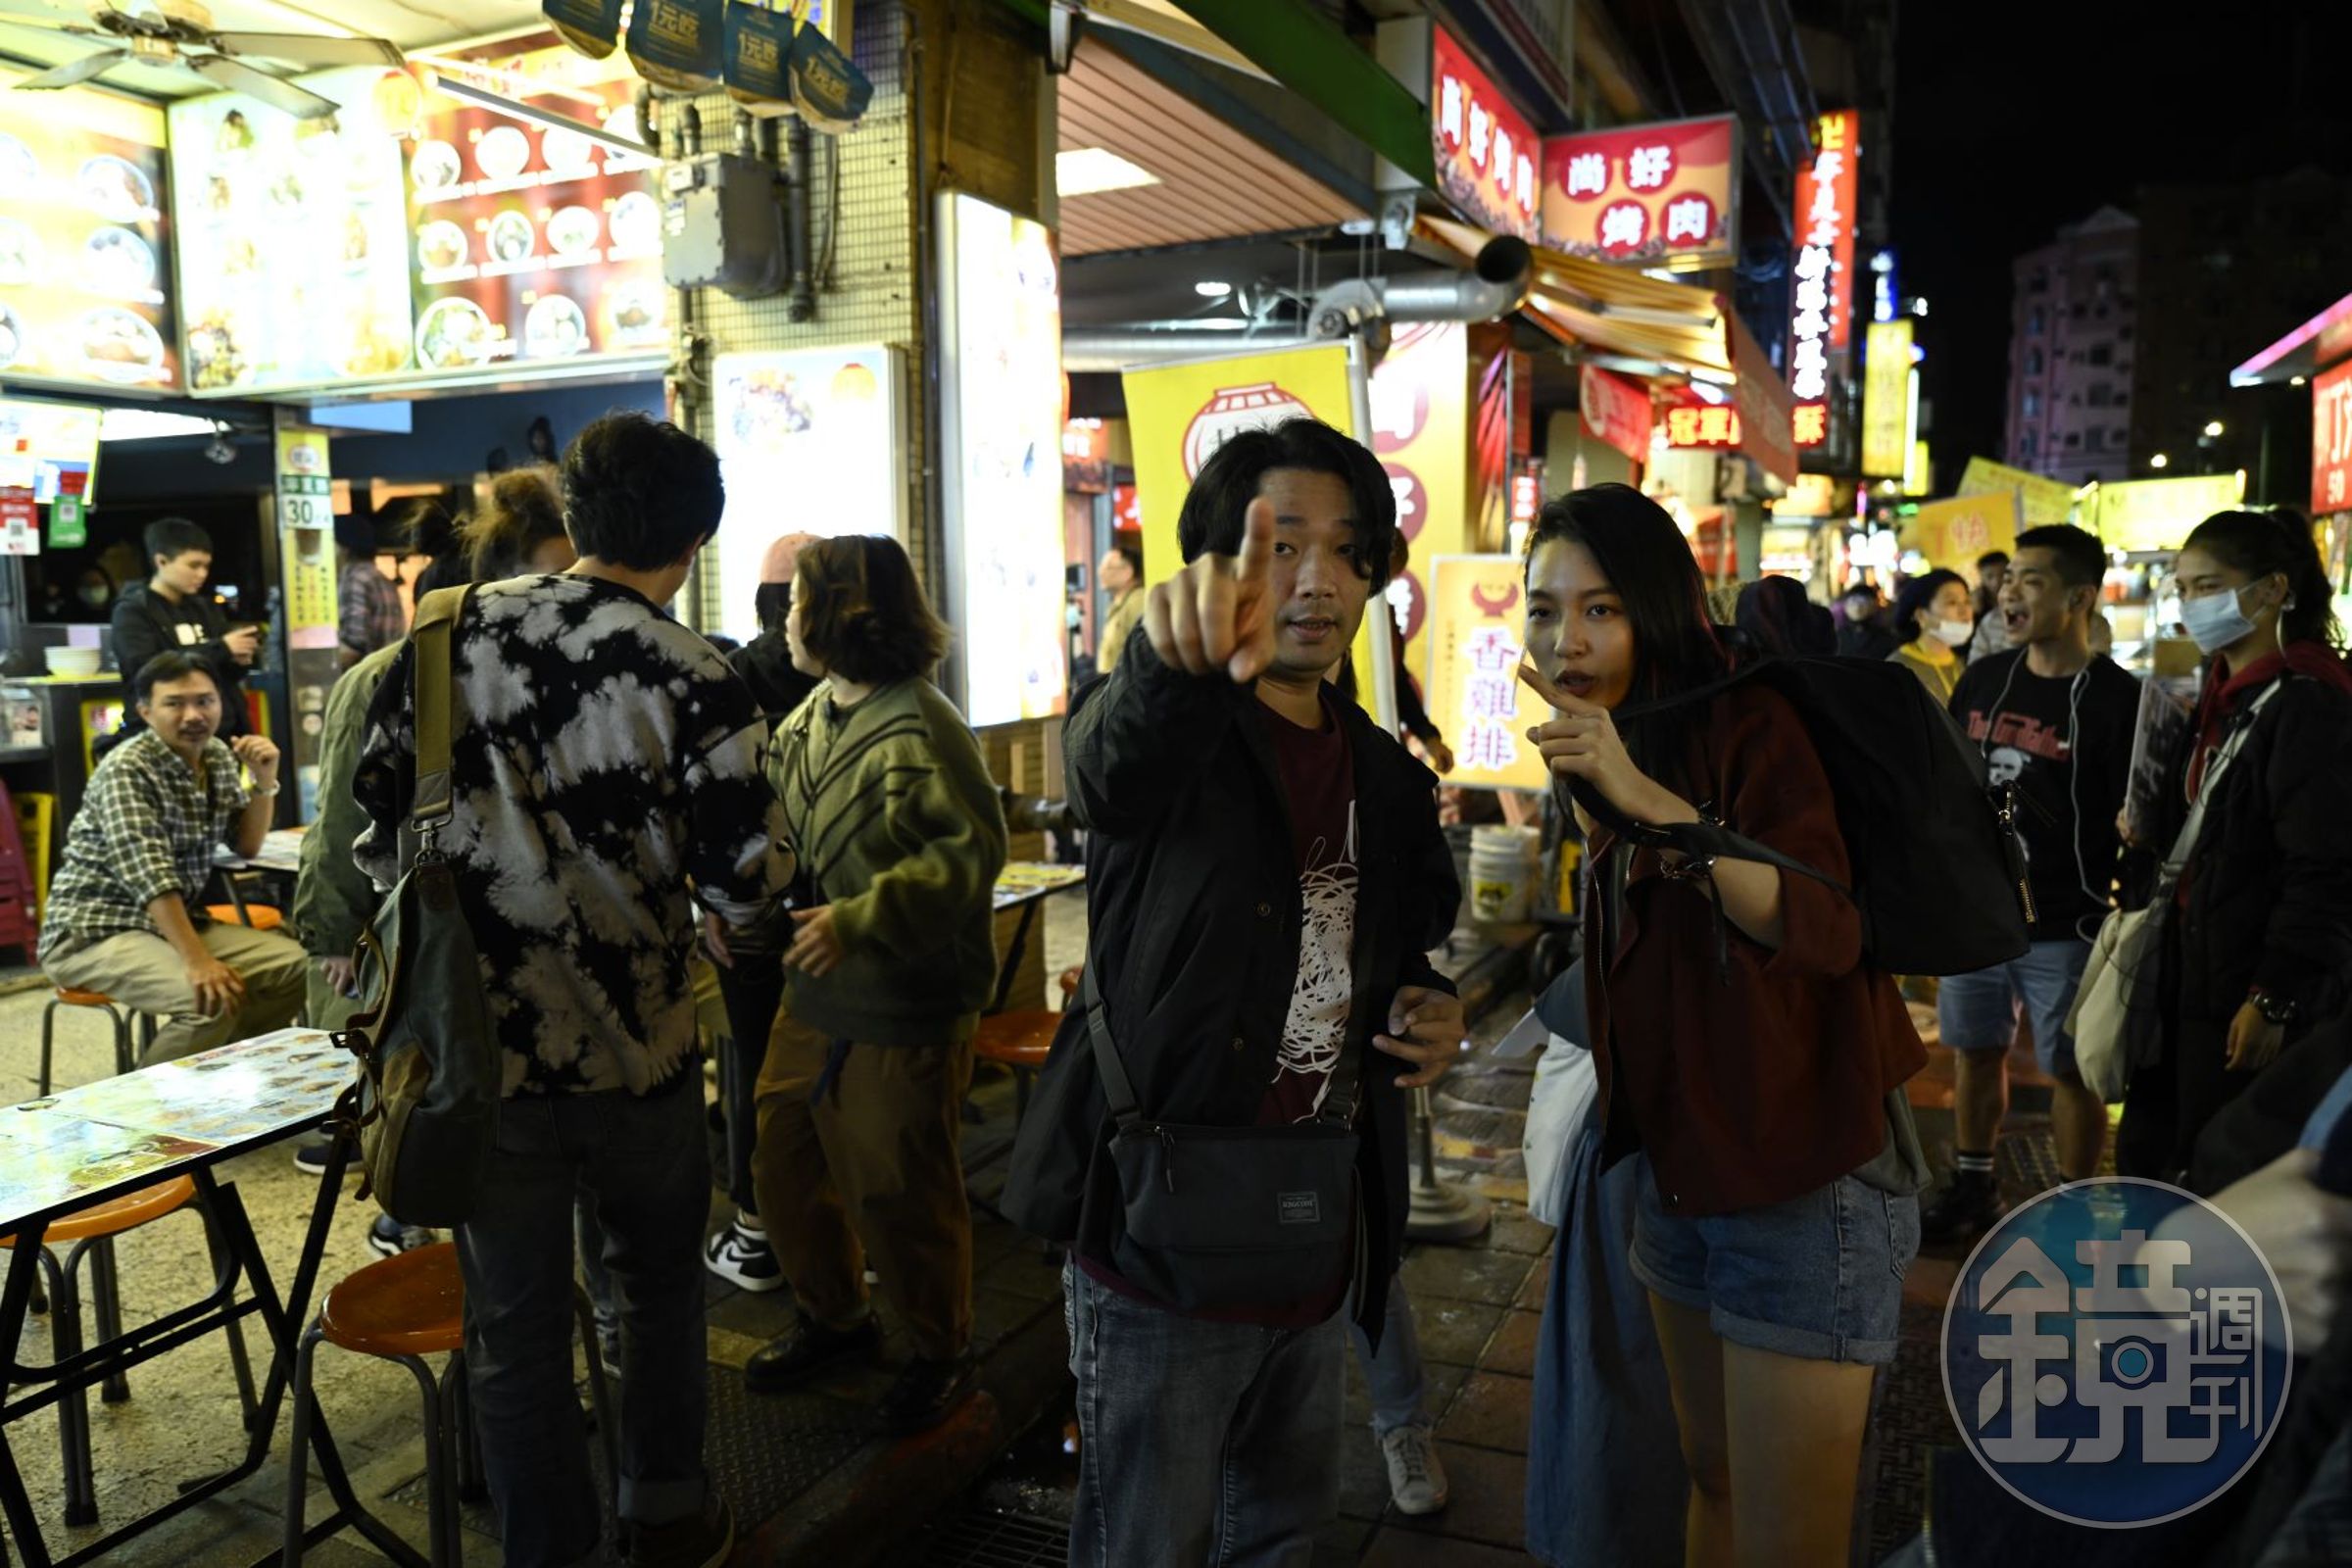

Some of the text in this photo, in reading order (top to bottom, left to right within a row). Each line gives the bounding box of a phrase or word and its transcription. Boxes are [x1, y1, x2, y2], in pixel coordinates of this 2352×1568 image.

[1568, 144, 1672, 197] 尚好
[1601, 198, 1709, 249] 烤肉
[288, 500, 314, 524] 30
